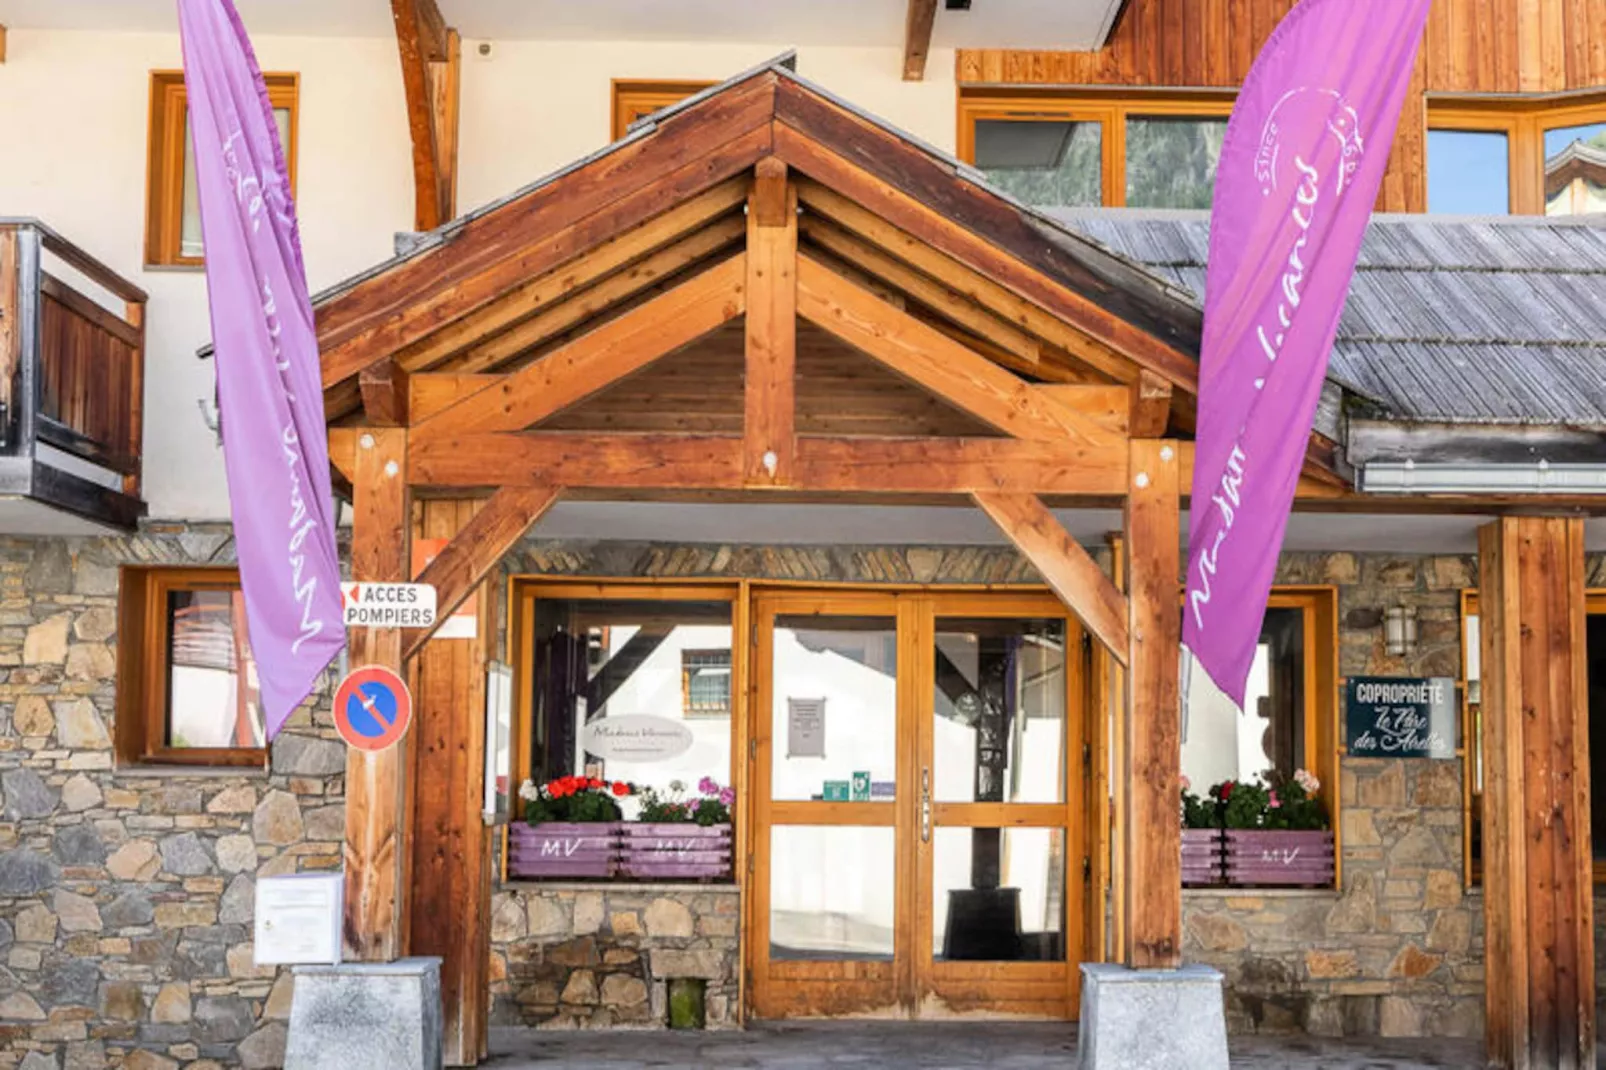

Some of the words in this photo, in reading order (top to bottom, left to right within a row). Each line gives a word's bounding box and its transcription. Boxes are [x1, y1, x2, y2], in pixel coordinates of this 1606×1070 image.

[364, 586, 417, 603] ACCES
[346, 607, 434, 625] POMPIERS
[540, 837, 584, 857] MV
